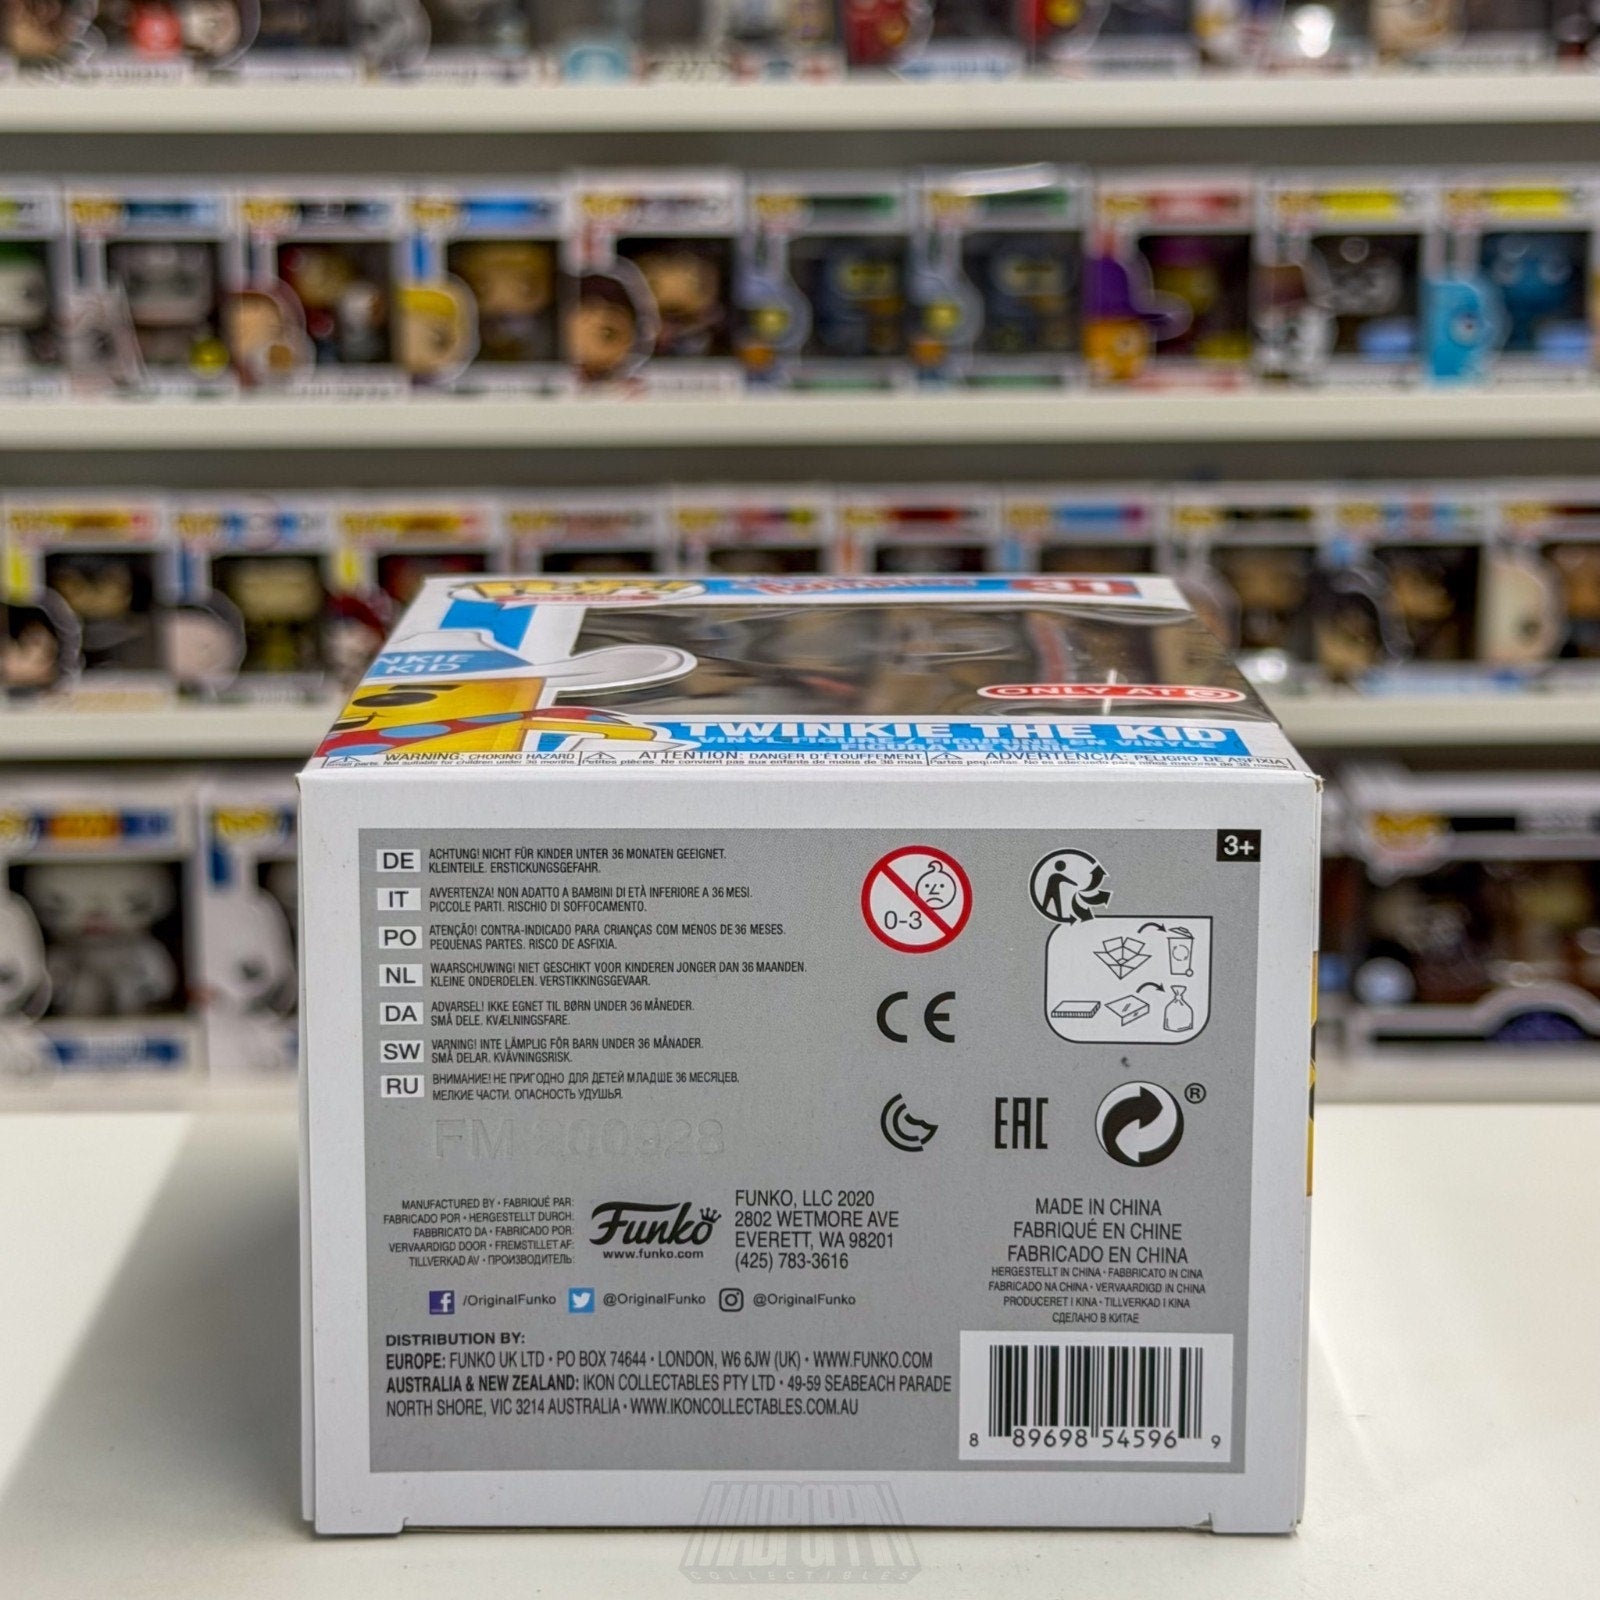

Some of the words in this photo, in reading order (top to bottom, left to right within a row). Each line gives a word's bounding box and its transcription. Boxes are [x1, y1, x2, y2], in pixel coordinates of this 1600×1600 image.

[386, 663, 461, 674] KID
[996, 687, 1109, 696] ONLY
[1126, 688, 1177, 697] AT
[681, 722, 953, 737] TWINKIE
[970, 724, 1096, 739] THE
[1114, 725, 1227, 742] KID
[1113, 739, 1218, 748] VINYLE
[385, 752, 464, 761] WARNING:
[469, 752, 524, 760] CHOKING
[640, 750, 744, 760] ATTENTION:
[750, 752, 805, 760] DANGER
[986, 752, 1127, 760] ADVERTENCIA:
[429, 848, 480, 860] ACHTUNG!
[482, 848, 510, 860] NICHT
[515, 848, 534, 860] FÜR
[537, 848, 573, 860] KINDER
[576, 848, 608, 860] UNTER
[612, 848, 624, 860] 36
[626, 847, 674, 860] MONATEN
[677, 847, 726, 860] GEEIGNET.
[1223, 836, 1255, 857] 3+
[384, 852, 415, 870] DE
[429, 862, 488, 874] KLEINTEILE.
[490, 862, 600, 874] ERSTICKUNGSGEFAHR.
[389, 891, 409, 908] IT
[430, 887, 494, 899] AVVERTENZA!
[497, 887, 519, 898] NON
[521, 886, 560, 898] ADATTO
[562, 886, 569, 898] A
[572, 886, 613, 898] BAMBINI
[616, 886, 626, 898] DI
[628, 884, 646, 898] ETÀ
[649, 886, 699, 898] INFERIORE
[702, 886, 709, 898] A
[712, 886, 724, 898] 36
[726, 886, 752, 898] MESI.
[884, 910, 923, 931] 0-3
[384, 929, 417, 946] PO
[386, 967, 416, 984] NL
[430, 962, 516, 974] WAARSCHUWING!
[518, 962, 538, 974] NIET
[543, 962, 590, 974] GESCHIKT
[595, 962, 622, 974] VOOR
[625, 962, 674, 973] KINDEREN
[677, 962, 716, 973] JONGER
[719, 962, 739, 973] DAN
[742, 961, 754, 973] 36
[756, 961, 806, 973] MAANDEN.
[431, 976, 464, 987] KLEINE
[468, 976, 538, 987] ONDERDELEN.
[540, 975, 650, 987] VERSTIKKINGSGEVAAR.
[876, 990, 956, 1043] CE
[383, 1043, 420, 1060] SW
[386, 1078, 419, 1096] RU
[994, 1096, 1049, 1149] EAC
[436, 1118, 514, 1159] FM
[402, 1198, 480, 1209] MANUFACTURED
[483, 1198, 494, 1208] BY
[503, 1197, 550, 1208] FABRIQUÉ
[553, 1197, 574, 1207] PAR:
[735, 1190, 799, 1207] FUNKO,
[803, 1190, 832, 1207] LLC
[838, 1189, 874, 1206] 2020
[1036, 1198, 1079, 1214] MADE
[1089, 1198, 1104, 1215] IN
[1110, 1199, 1162, 1216] CHINA
[383, 1214, 438, 1223] FABRICADO
[440, 1213, 461, 1223] POR
[469, 1212, 534, 1222] HERGESTELLT
[538, 1212, 574, 1221] DURCH:
[590, 1201, 712, 1246] Funko
[735, 1211, 772, 1228] 2802
[777, 1210, 862, 1228] WETMORE
[868, 1210, 898, 1227] AVE
[1014, 1218, 1097, 1239] FABRIQUÉ
[1103, 1222, 1126, 1240] EN
[1130, 1223, 1182, 1240] CHINE
[735, 1231, 813, 1249] EVERETT,
[820, 1231, 845, 1249] WA
[849, 1231, 894, 1249] 98201
[603, 1250, 703, 1259] www.funko.com
[735, 1252, 773, 1272] (425)
[780, 1251, 848, 1271] 783-3616
[1008, 1246, 1104, 1263] FABRICADO
[1109, 1246, 1131, 1263] EN
[1137, 1246, 1188, 1264] CHINA
[992, 1267, 1057, 1277] HERGESTELLT
[1060, 1268, 1070, 1277] IN
[1072, 1268, 1101, 1278] CHINA
[1108, 1268, 1166, 1278] FABBRICATO
[1169, 1269, 1178, 1278] IN
[1180, 1269, 1203, 1278] CINA
[463, 1294, 556, 1307] /OriginalFunko
[603, 1293, 706, 1306] @OriginalFunko
[753, 1294, 856, 1307] @OriginalFunko
[1052, 1314, 1098, 1324] СДЕЛАНО
[1100, 1314, 1107, 1324] В
[1109, 1314, 1139, 1323] КИТАЕ
[386, 1332, 495, 1347] DISTRIBUTION
[500, 1332, 525, 1346] BY:
[386, 1352, 445, 1370] EUROPE:
[450, 1352, 496, 1370] FUNKO
[500, 1352, 517, 1370] UK
[521, 1352, 545, 1370] LTD
[556, 1352, 576, 1370] PO
[579, 1352, 606, 1370] BOX
[612, 1352, 646, 1370] 74644
[658, 1351, 719, 1370] LONDON,
[722, 1351, 741, 1370] W6
[744, 1351, 770, 1370] 6JW
[774, 1351, 801, 1370] (UK)
[814, 1350, 933, 1370] WWW.FUNKO.COM
[387, 1375, 462, 1393] AUSTRALIA
[466, 1375, 474, 1393] &
[478, 1375, 508, 1393] NEW
[512, 1375, 579, 1393] ZEALAND:
[583, 1375, 615, 1393] IKON
[618, 1375, 719, 1393] COLLECTABLES
[723, 1375, 747, 1393] PTY
[752, 1375, 775, 1393] LTD
[788, 1375, 821, 1393] 49-59
[825, 1375, 896, 1393] SEABEACH
[899, 1375, 952, 1393] PARADE
[387, 1399, 433, 1417] NORTH
[437, 1399, 487, 1417] SHORE,
[491, 1399, 512, 1417] VIC
[516, 1399, 544, 1417] 3214
[548, 1399, 620, 1417] AUSTRALIA
[631, 1399, 858, 1417] WWW.IKONCOLLECTABLES.COM.AU
[969, 1432, 979, 1448] 8
[1012, 1429, 1088, 1448] 89698
[1102, 1430, 1177, 1448] 54596
[1211, 1434, 1221, 1448] 9
